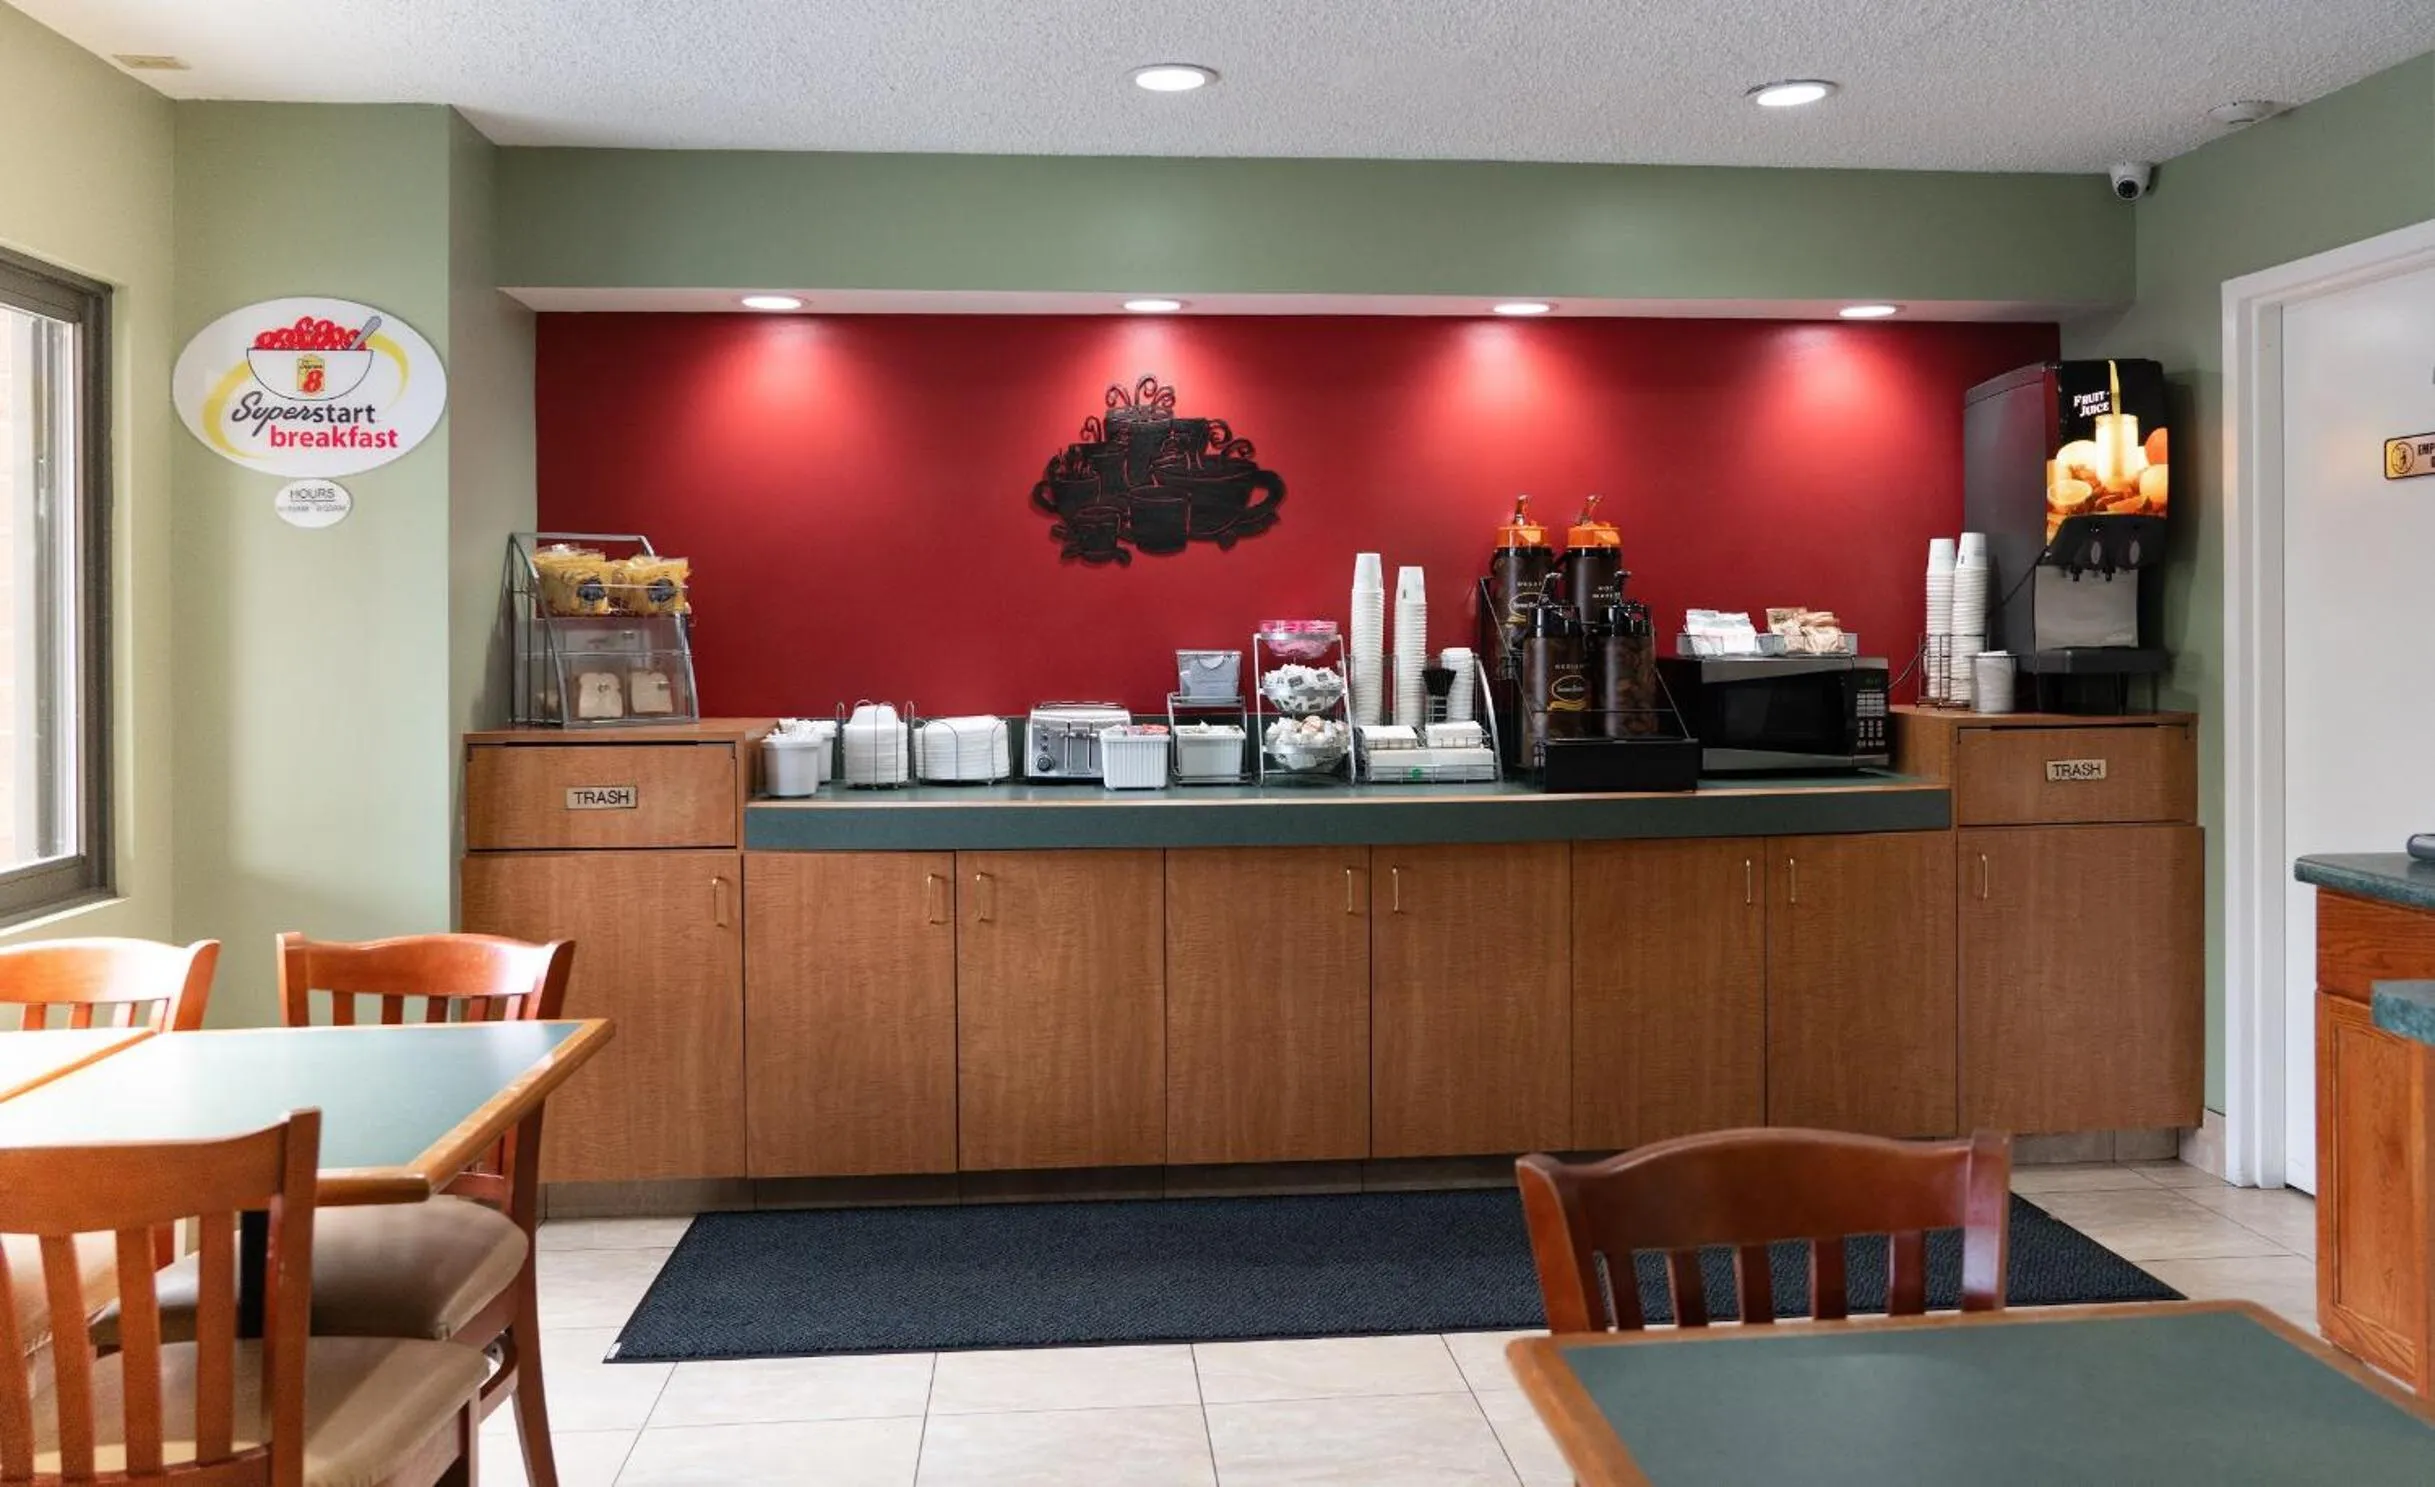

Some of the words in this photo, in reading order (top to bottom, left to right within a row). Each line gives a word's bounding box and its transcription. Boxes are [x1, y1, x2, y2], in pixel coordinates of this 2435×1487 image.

[2073, 390, 2105, 407] FRUIT
[231, 390, 376, 437] Superstart
[2080, 402, 2109, 418] JUICE
[270, 425, 398, 448] breakfast
[290, 487, 335, 499] HOURS
[2051, 762, 2101, 777] TRASH
[573, 790, 629, 805] TRASH
